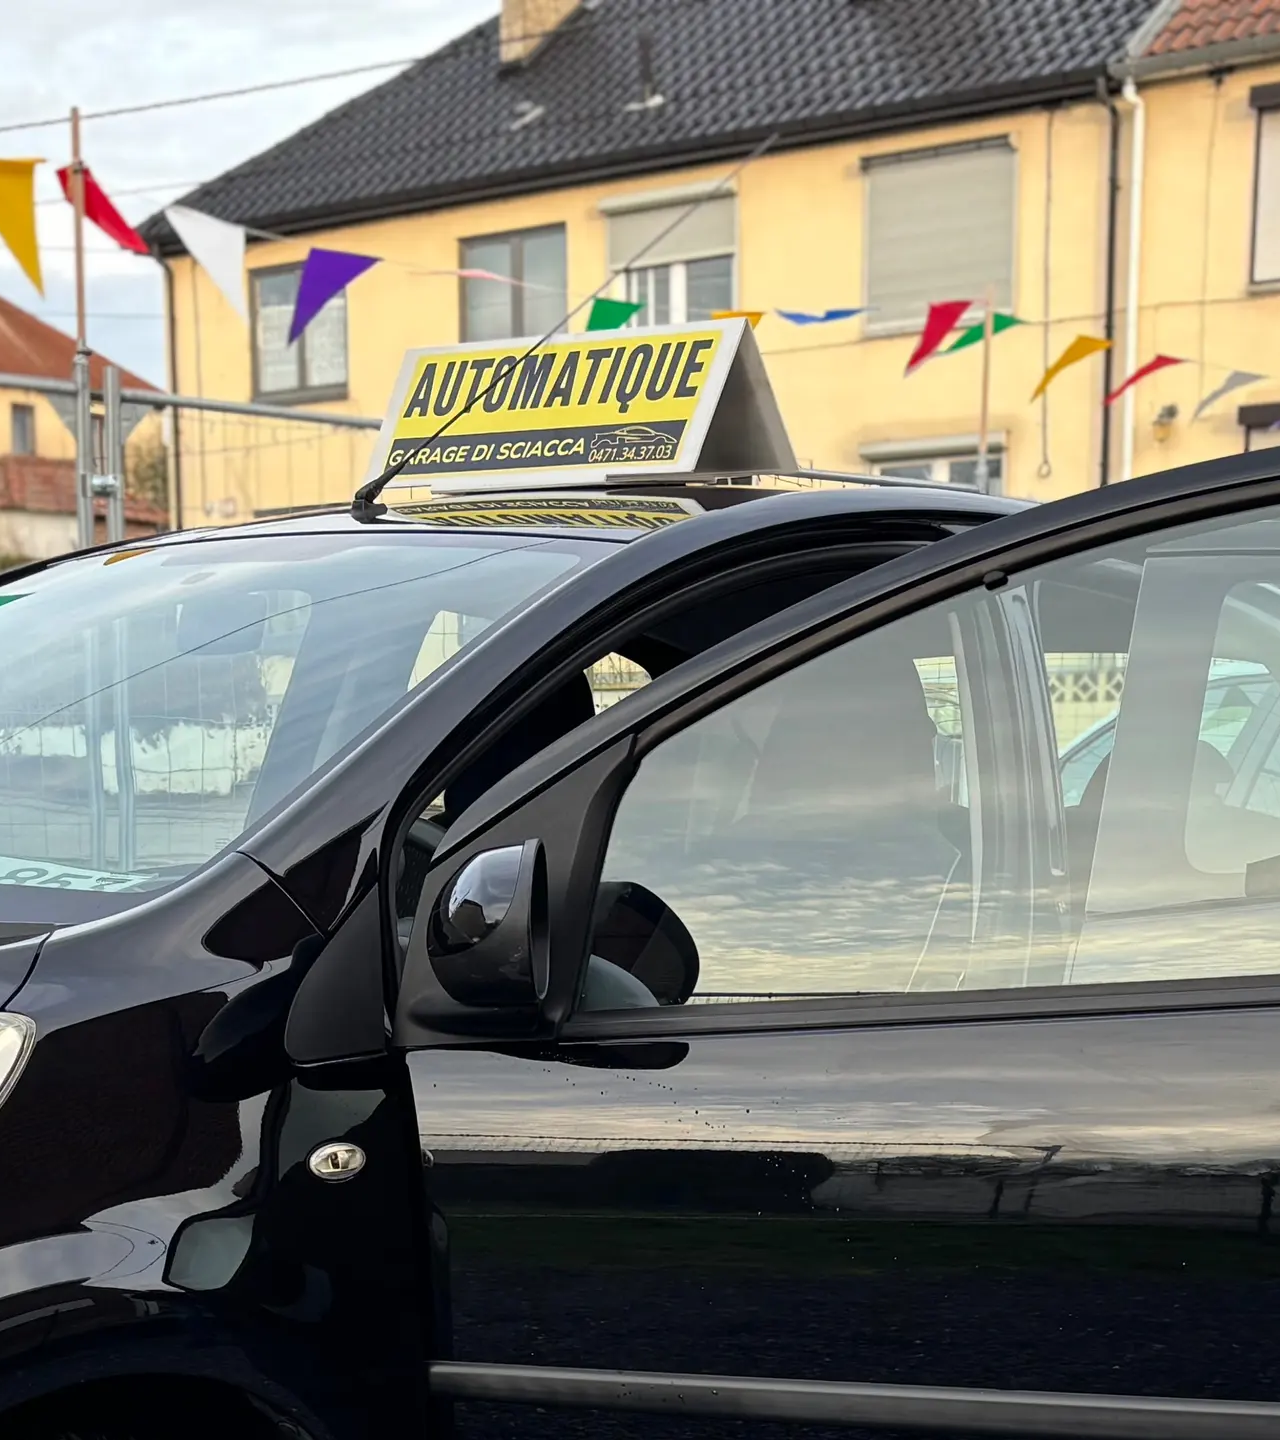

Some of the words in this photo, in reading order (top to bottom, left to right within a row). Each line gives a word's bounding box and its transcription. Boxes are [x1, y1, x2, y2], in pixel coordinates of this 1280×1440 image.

[403, 339, 715, 418] AUTOMATIQUE
[389, 446, 470, 466] GARAGE
[471, 443, 494, 461] DI
[496, 438, 585, 460] SCIACCA
[588, 445, 673, 463] 0471.34.37.03
